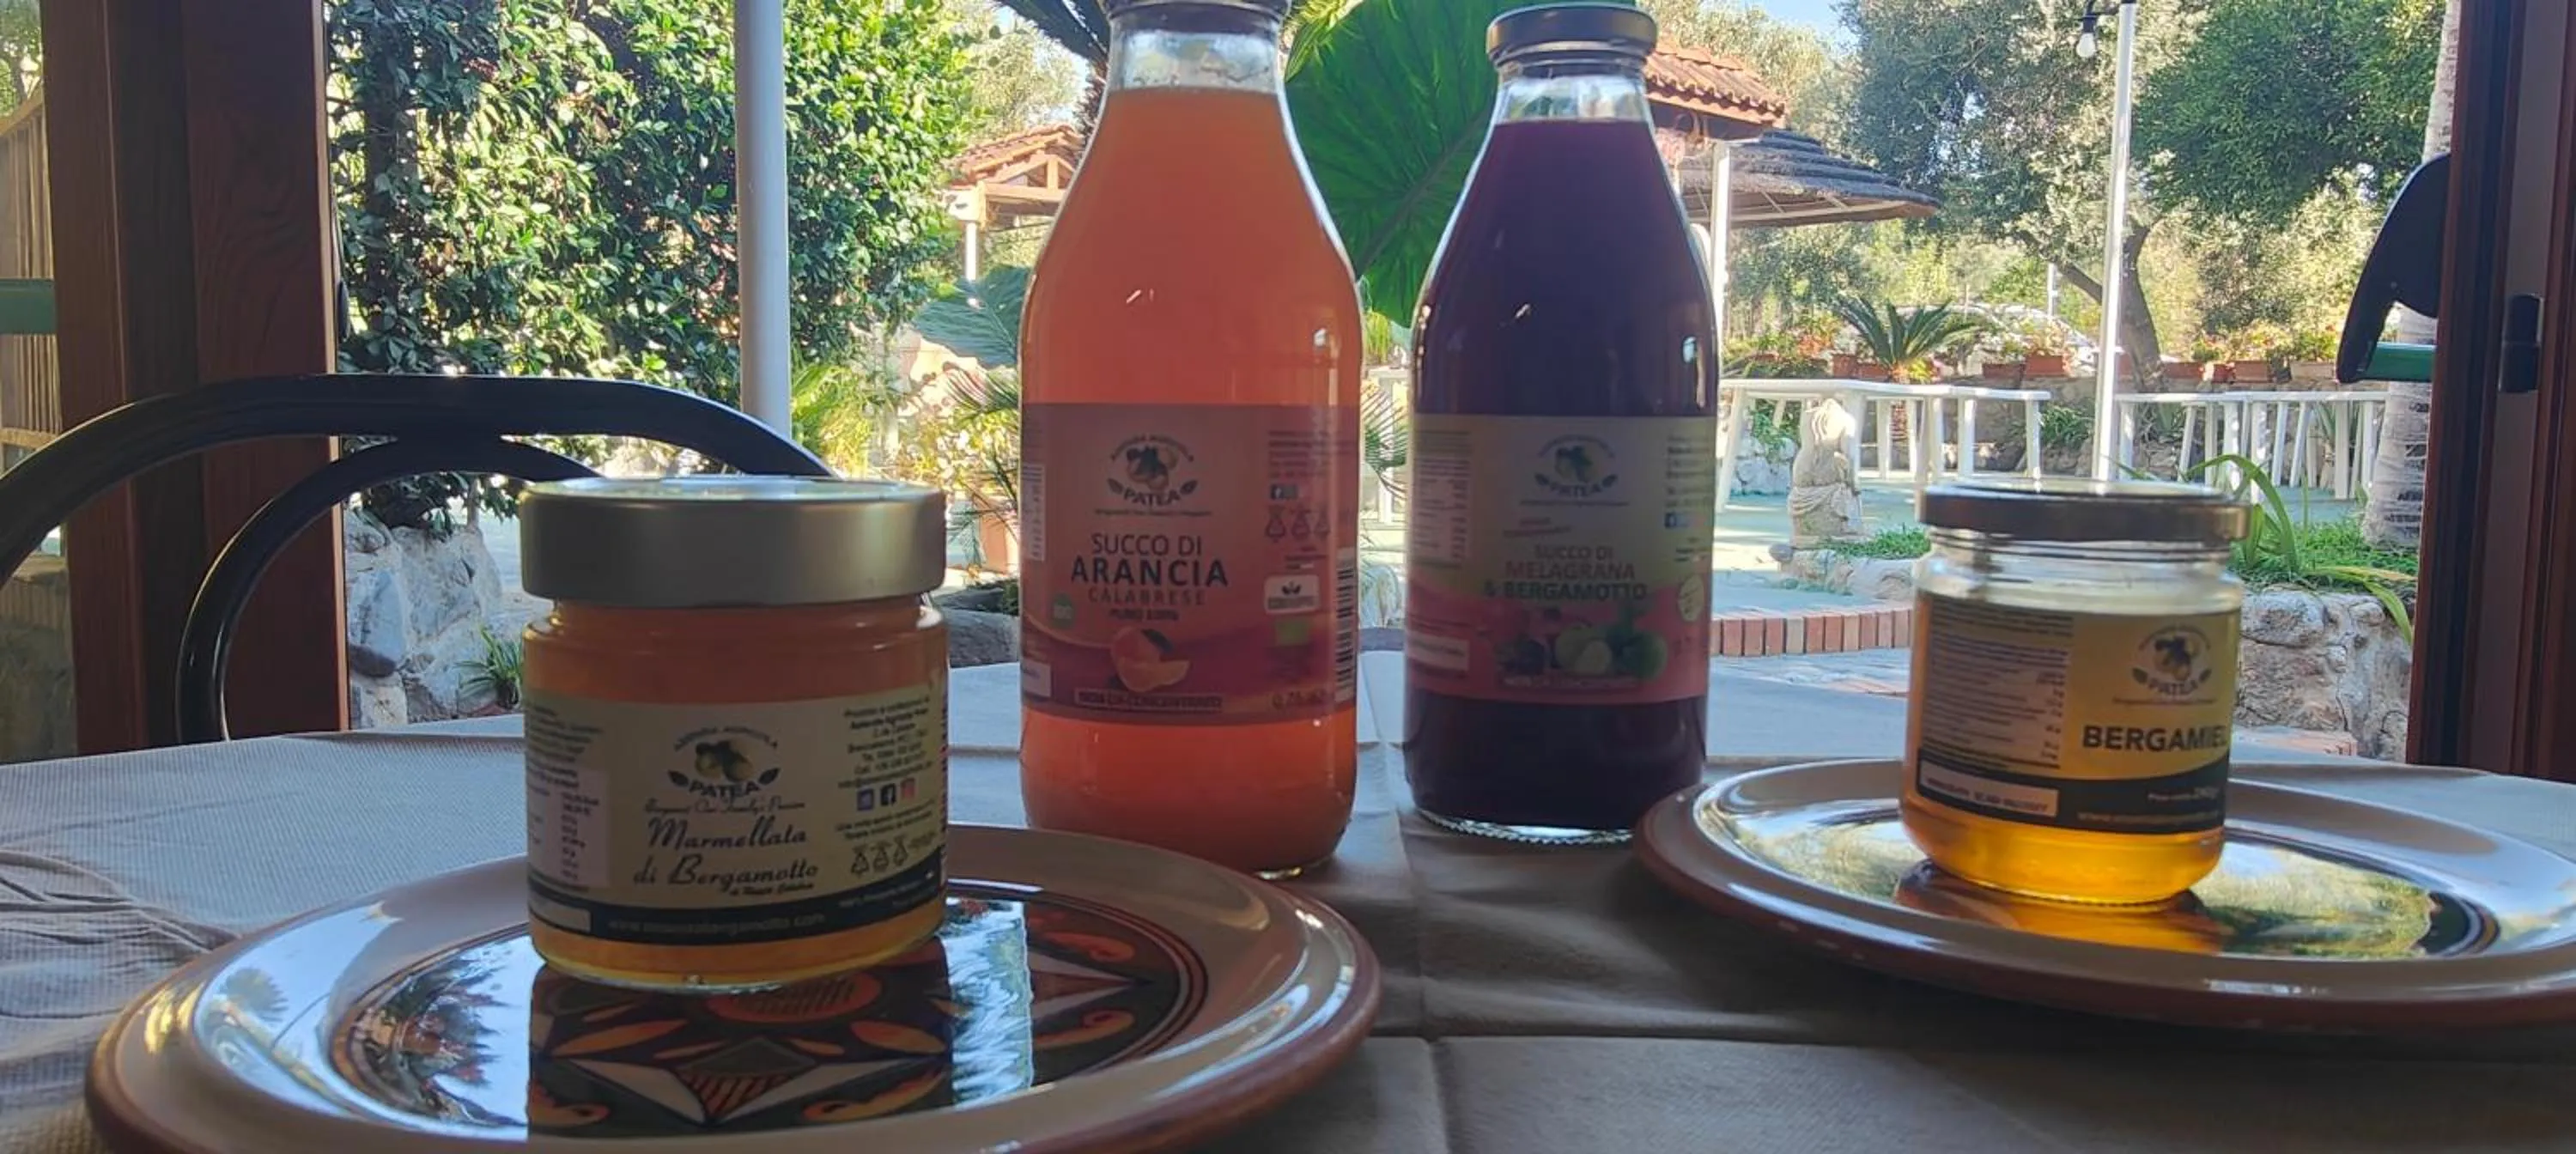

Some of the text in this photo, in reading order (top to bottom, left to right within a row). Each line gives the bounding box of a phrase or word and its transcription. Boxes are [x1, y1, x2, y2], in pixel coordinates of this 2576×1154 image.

[1123, 487, 1181, 507] PATEA
[1091, 532, 1202, 557] SUCCO DI
[1070, 554, 1229, 587] ARANCIA
[1504, 560, 1636, 581] MELAGRANA
[1087, 586, 1206, 606] CALABRESE
[1503, 580, 1648, 601] BERGAMOTTO
[688, 780, 762, 799] PATEA
[647, 814, 807, 851] Marmellata
[632, 853, 658, 885] di
[666, 853, 819, 894] Bergamotto
